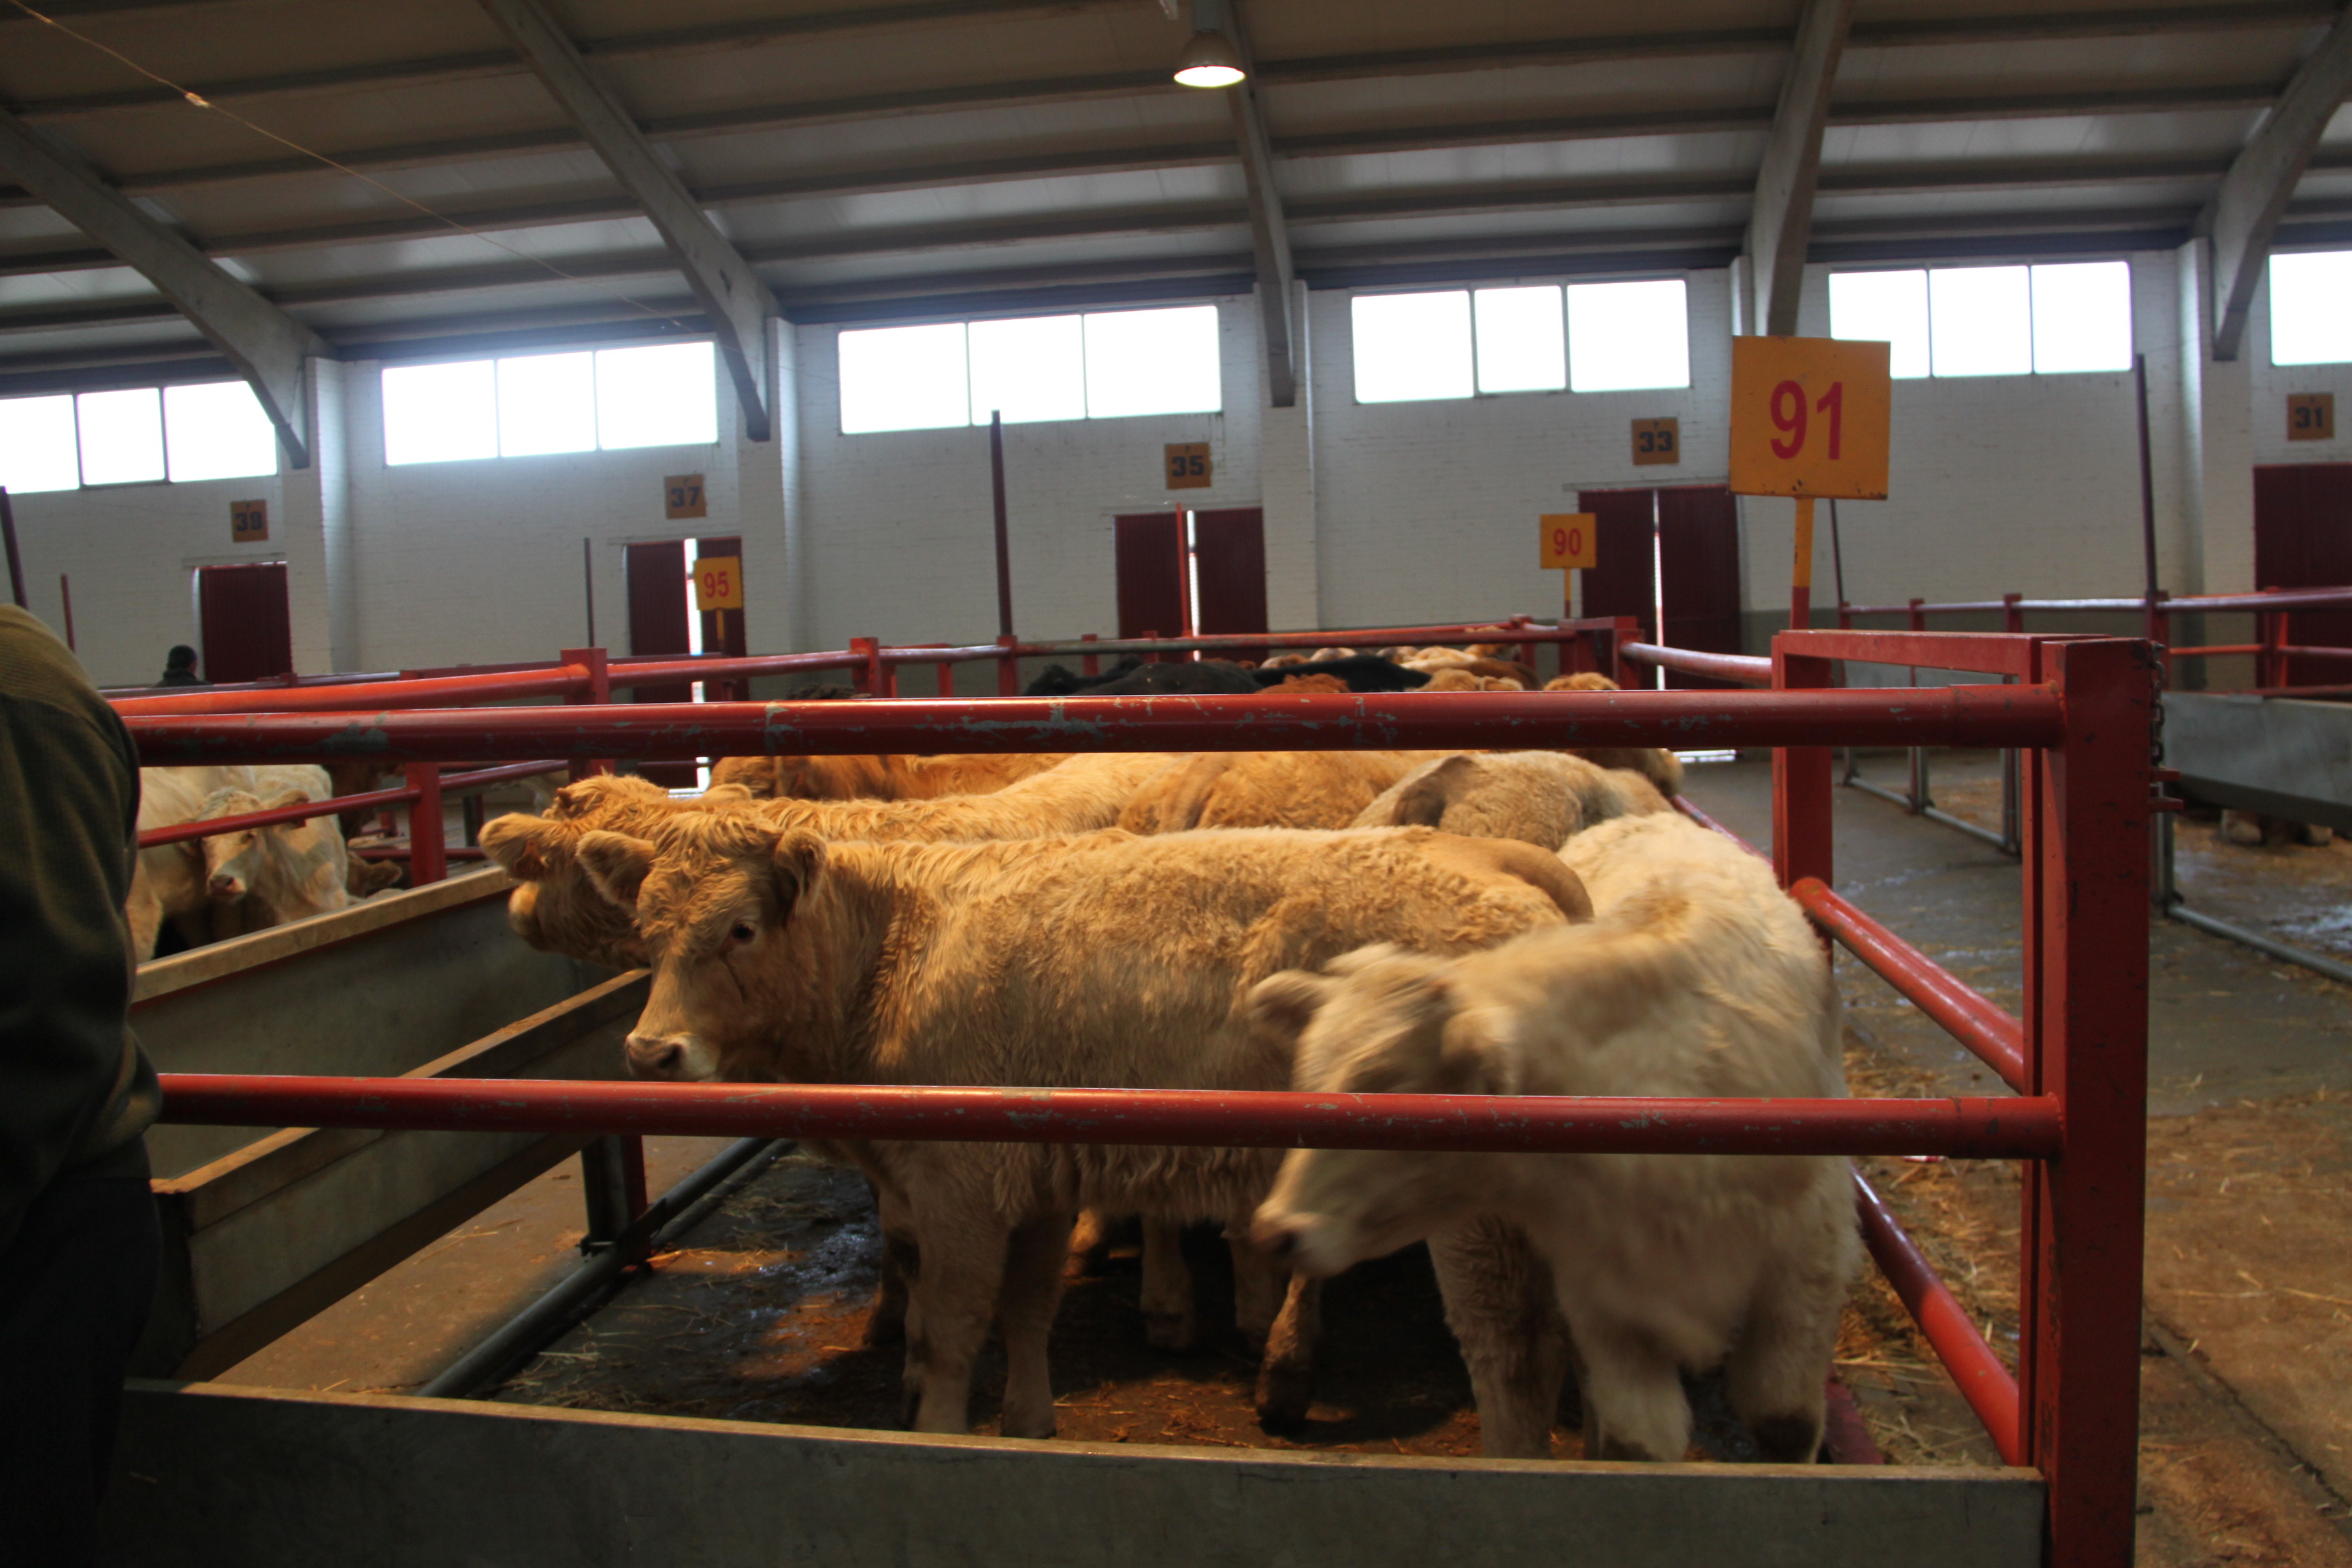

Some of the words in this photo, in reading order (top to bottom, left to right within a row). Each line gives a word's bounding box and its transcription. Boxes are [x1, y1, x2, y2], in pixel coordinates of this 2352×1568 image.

[1770, 379, 1843, 460] 91
[2296, 406, 2323, 428] 31
[1639, 430, 1673, 453] 33
[1171, 454, 1205, 477] 35
[670, 486, 700, 507] 37
[235, 511, 263, 532] 39
[1553, 527, 1582, 556] 90
[704, 570, 730, 598] 95
